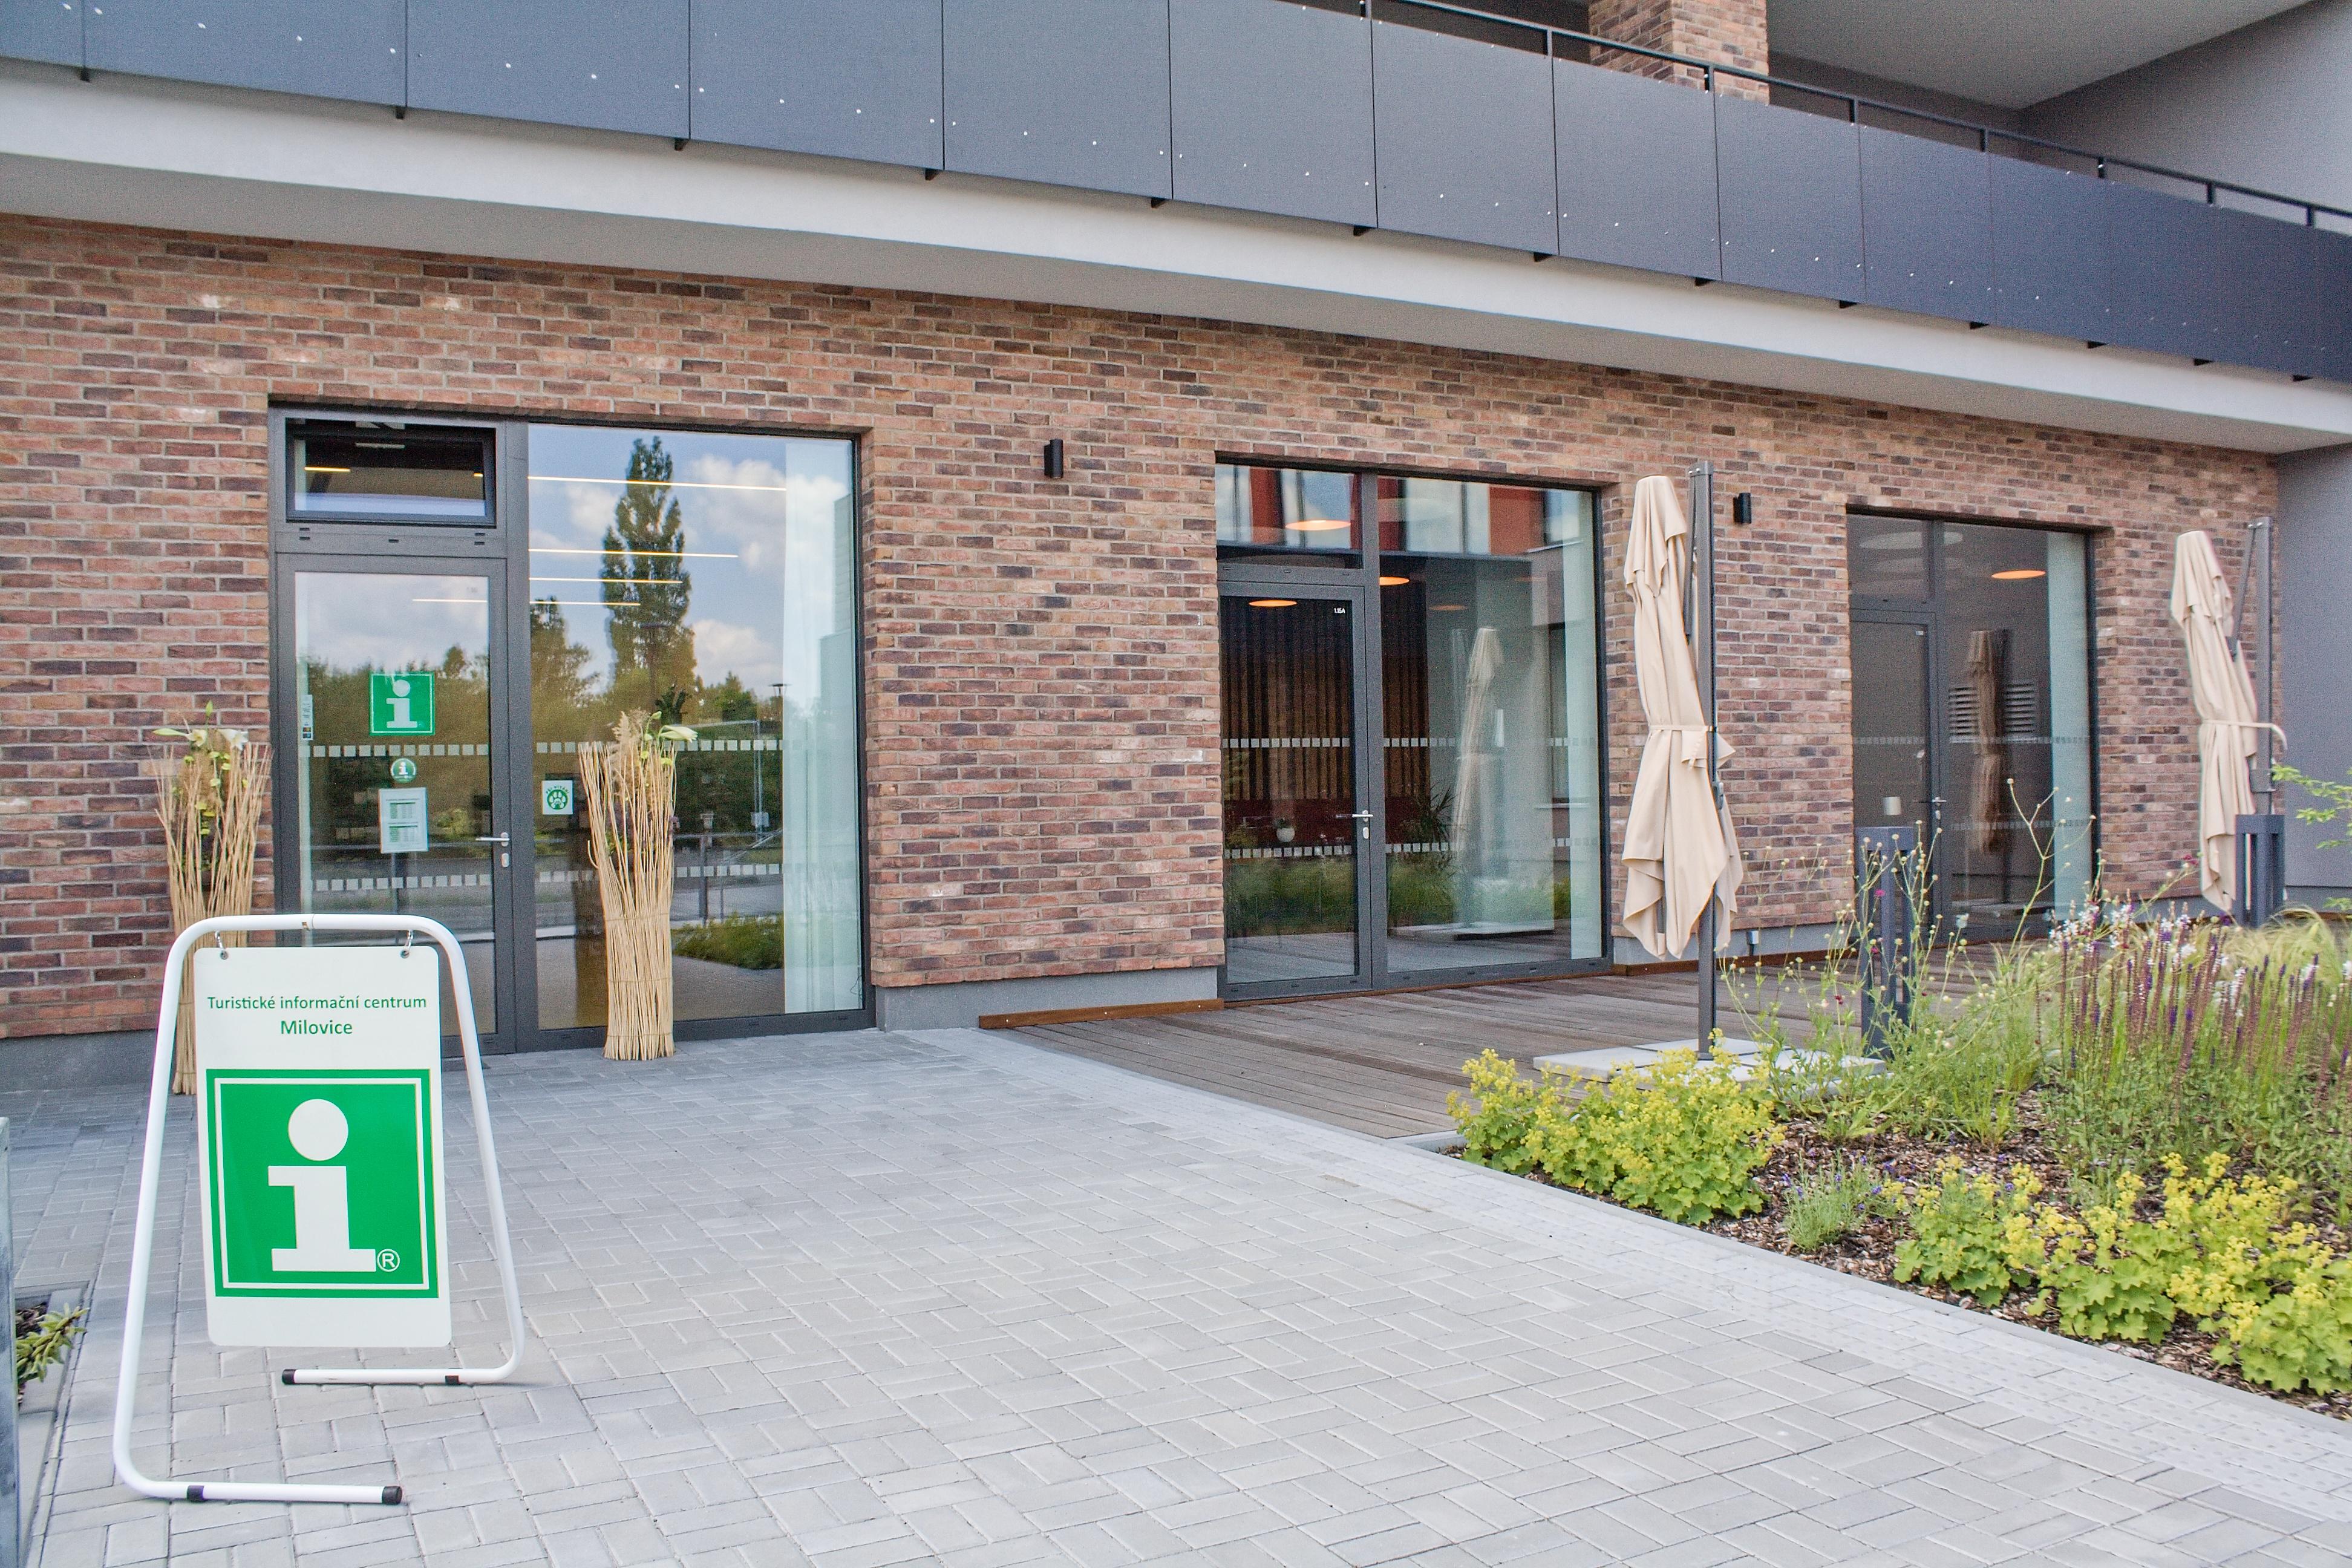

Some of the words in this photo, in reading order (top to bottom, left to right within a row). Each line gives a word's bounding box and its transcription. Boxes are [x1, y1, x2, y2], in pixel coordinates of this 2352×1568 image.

[207, 995, 276, 1009] Turistické
[280, 995, 360, 1009] informační
[364, 996, 427, 1008] centrum
[281, 1019, 353, 1034] Milovice
